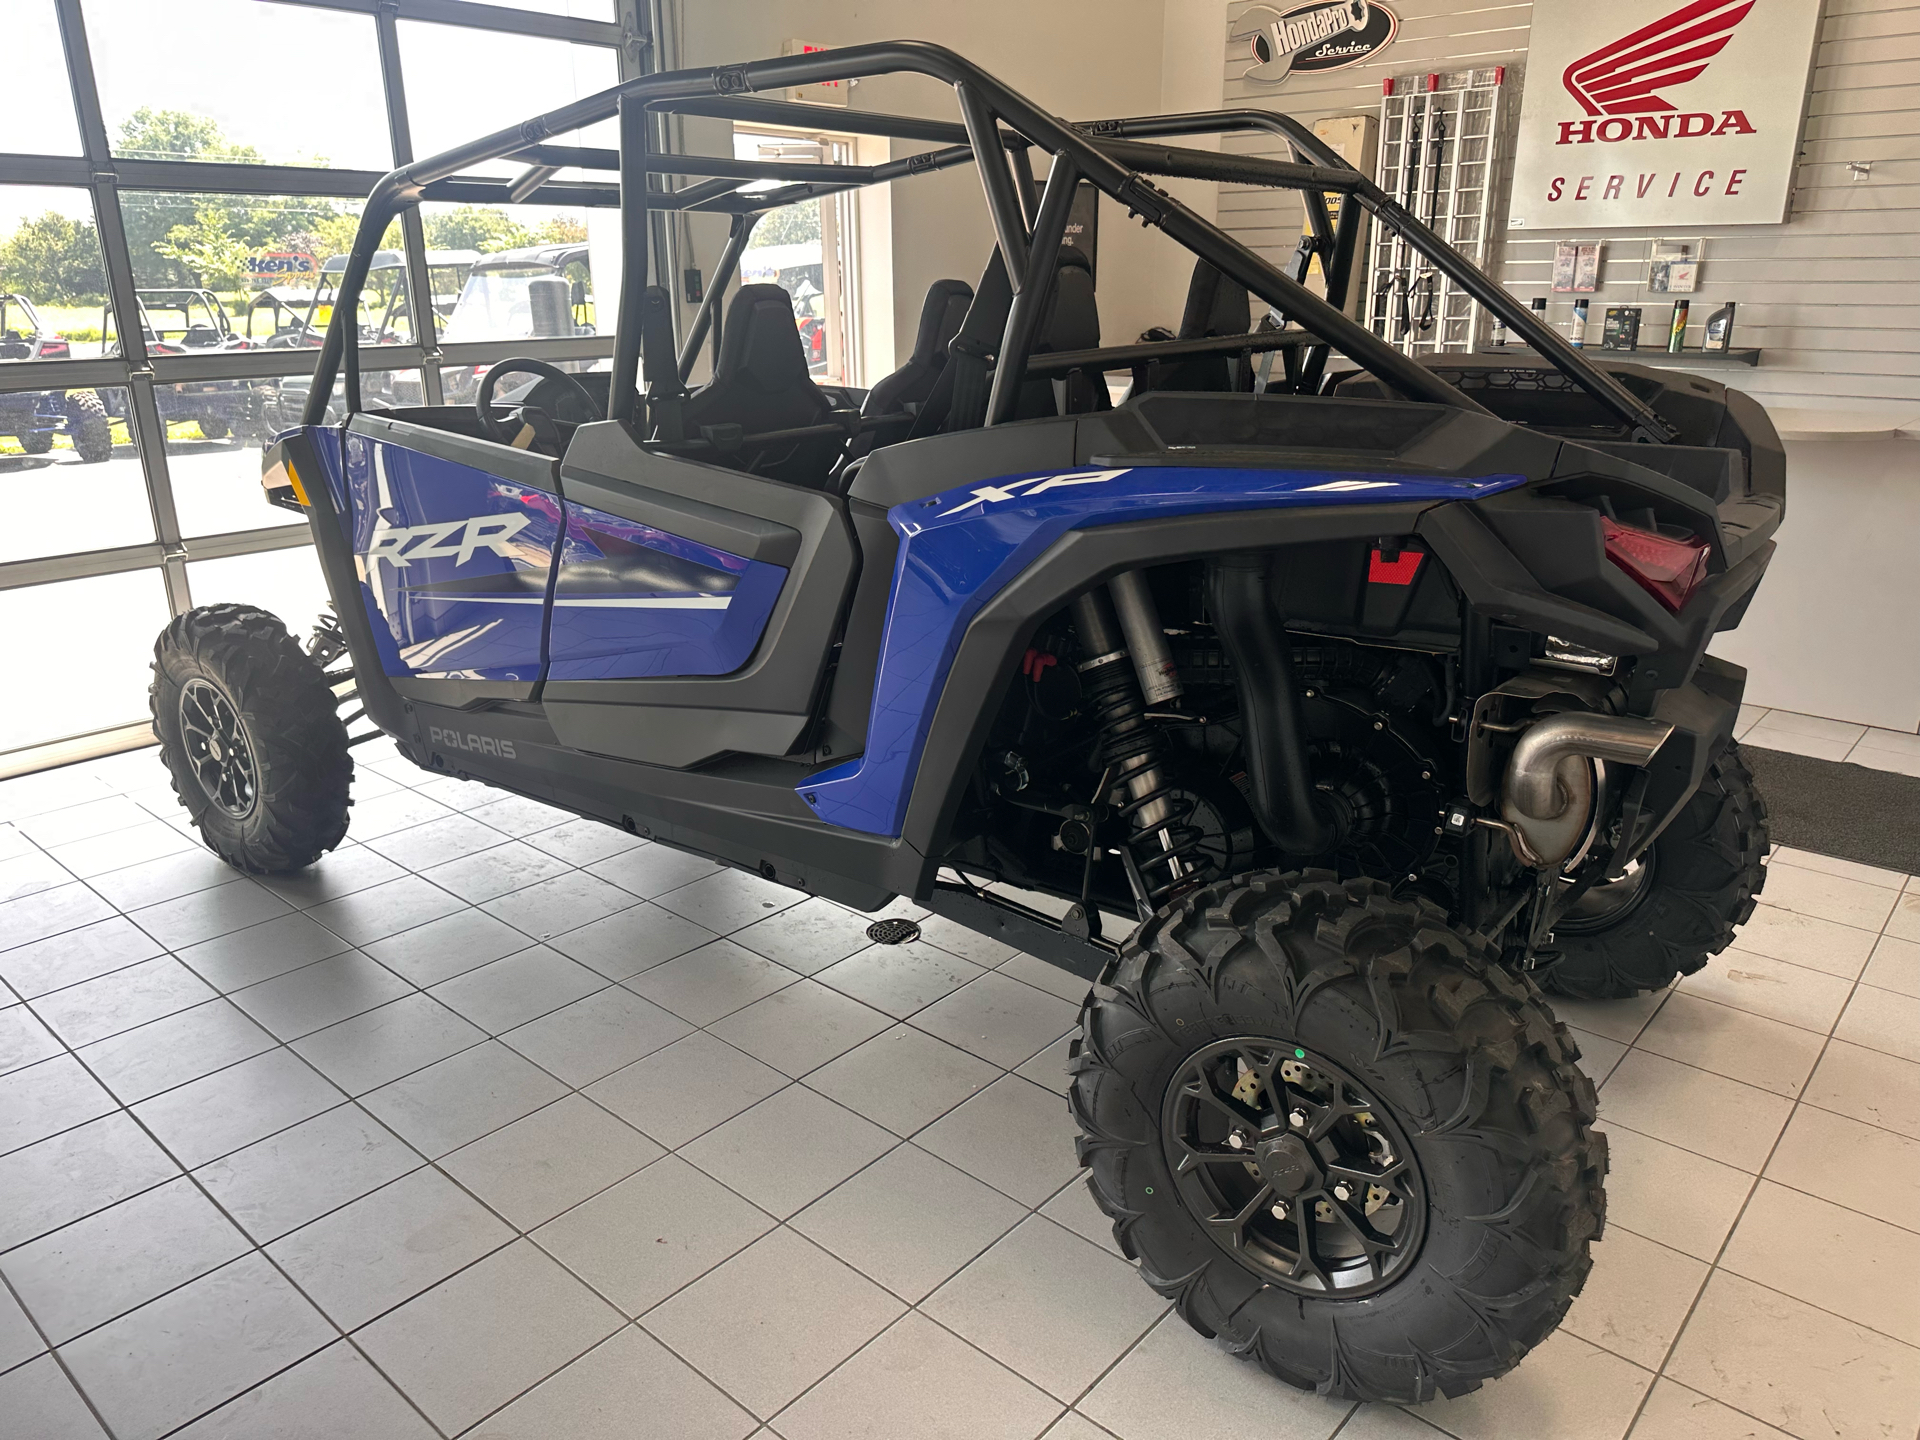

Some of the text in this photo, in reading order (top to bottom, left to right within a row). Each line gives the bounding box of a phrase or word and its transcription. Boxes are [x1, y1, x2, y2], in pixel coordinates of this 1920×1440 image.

[1270, 7, 1349, 57] HondaPro
[1315, 40, 1372, 57] Service
[1555, 109, 1757, 145] HONDA
[1547, 169, 1747, 202] SERVICE
[248, 255, 310, 273] ken's
[934, 468, 1134, 518] XP
[365, 511, 532, 575] RZR
[429, 726, 517, 760] POLARIS
